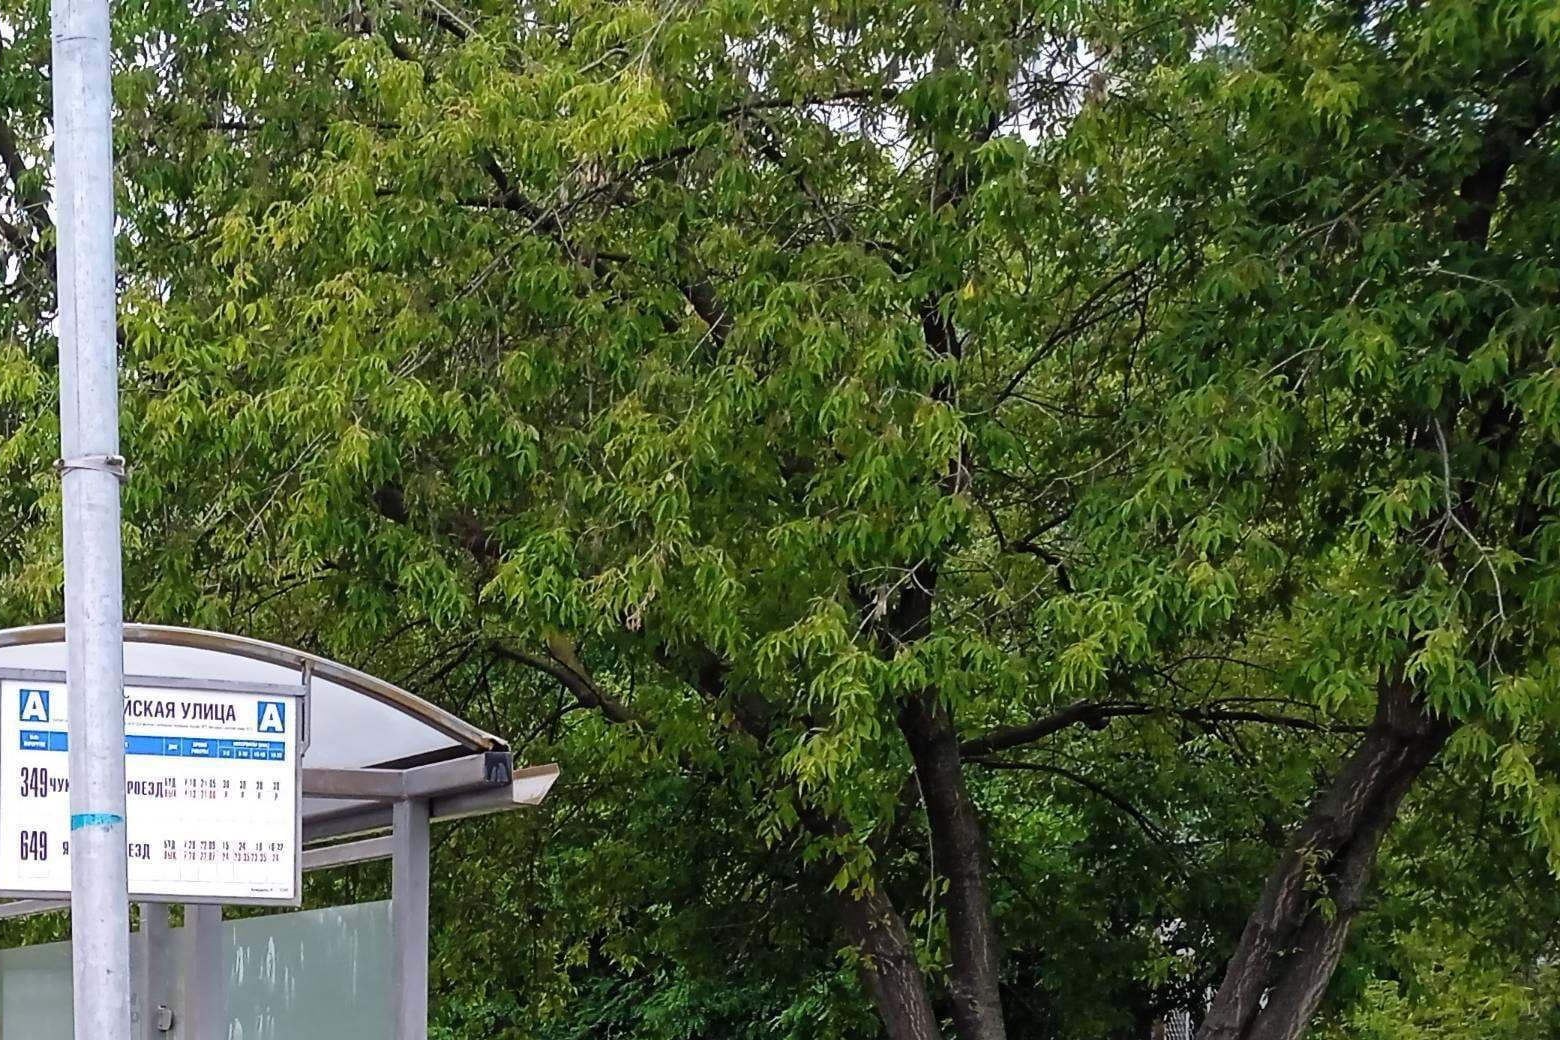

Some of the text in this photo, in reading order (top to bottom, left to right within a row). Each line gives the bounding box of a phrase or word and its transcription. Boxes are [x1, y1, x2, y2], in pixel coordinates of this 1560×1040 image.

[181, 702, 237, 723] УЛИЦА
[20, 767, 48, 798] 349
[20, 830, 48, 861] 649
